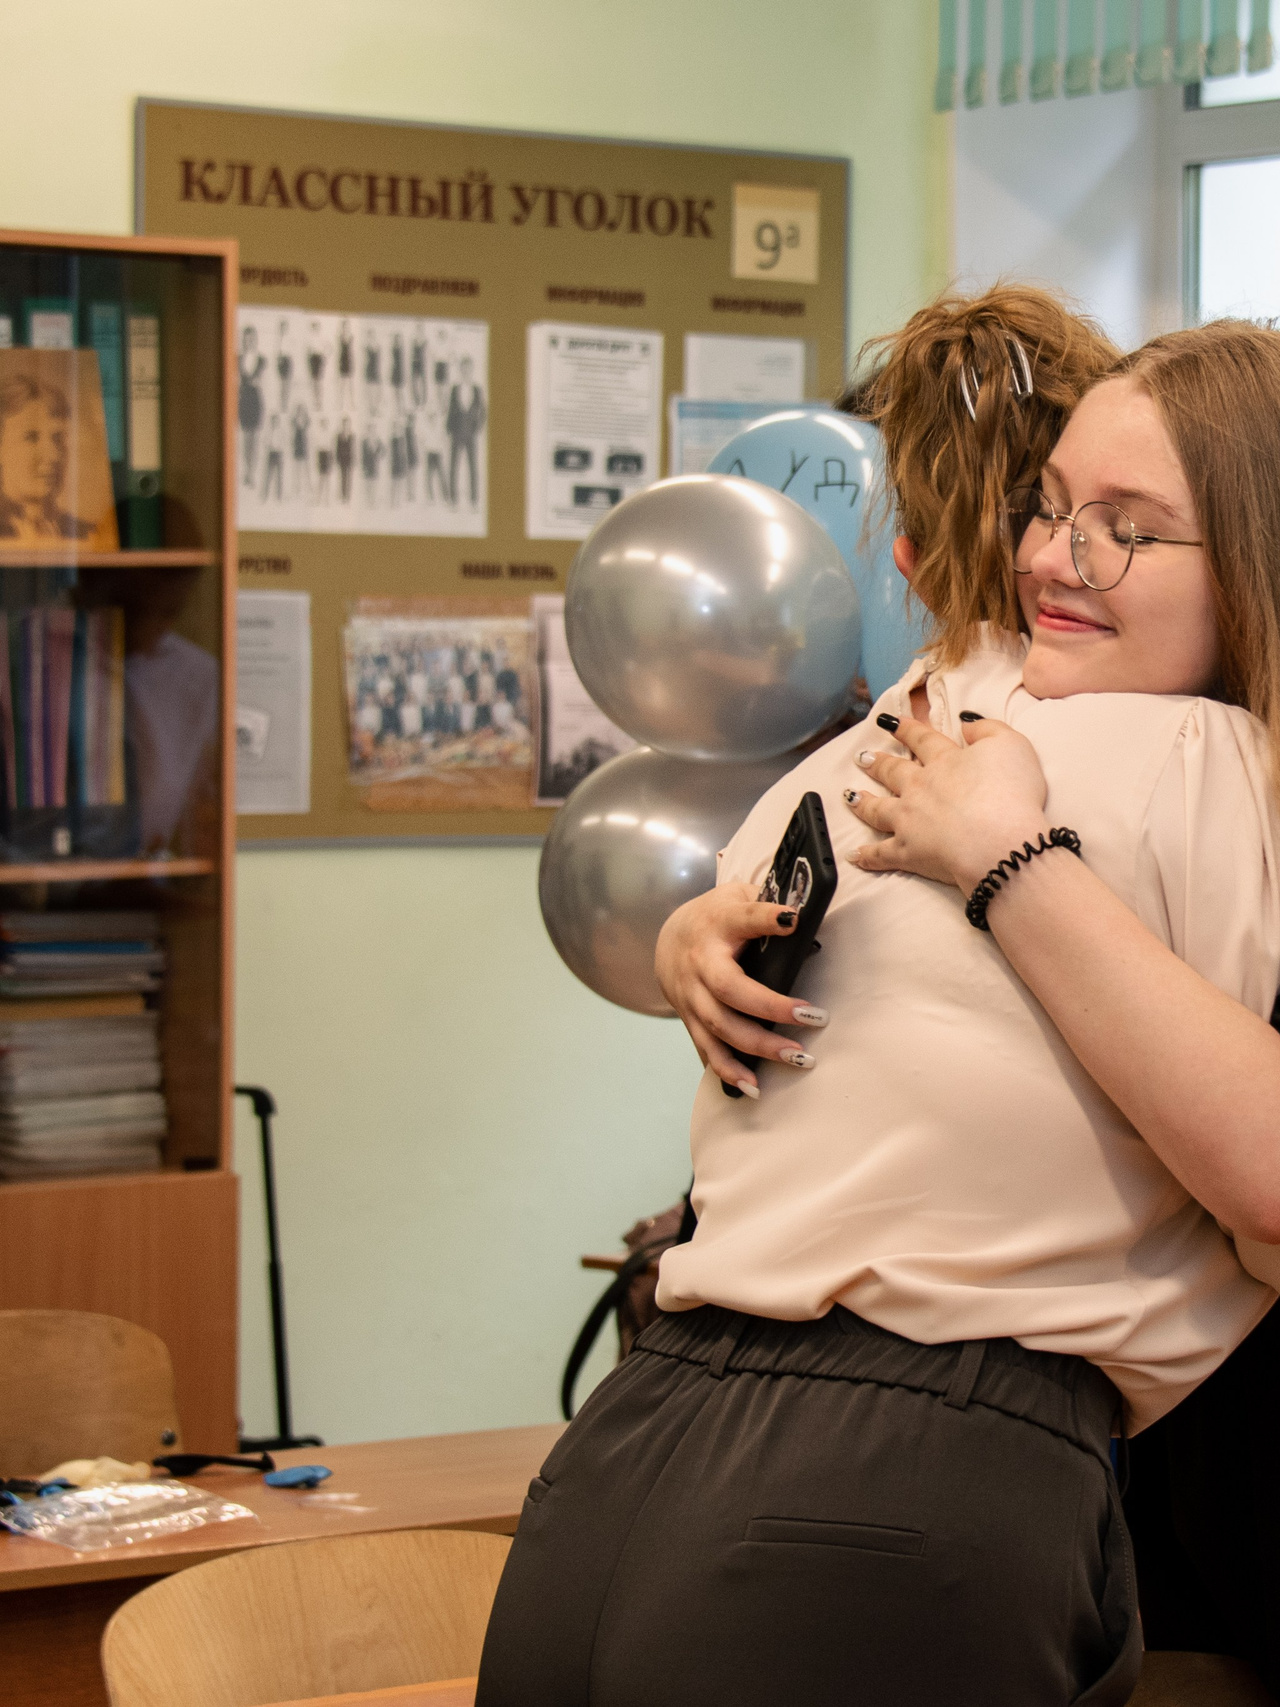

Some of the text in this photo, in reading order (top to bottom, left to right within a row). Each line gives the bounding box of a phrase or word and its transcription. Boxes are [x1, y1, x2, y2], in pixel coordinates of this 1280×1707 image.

[181, 158, 716, 239] КЛАССНЫЙ УГОЛОК
[240, 266, 309, 287] ОРДОСТЬ
